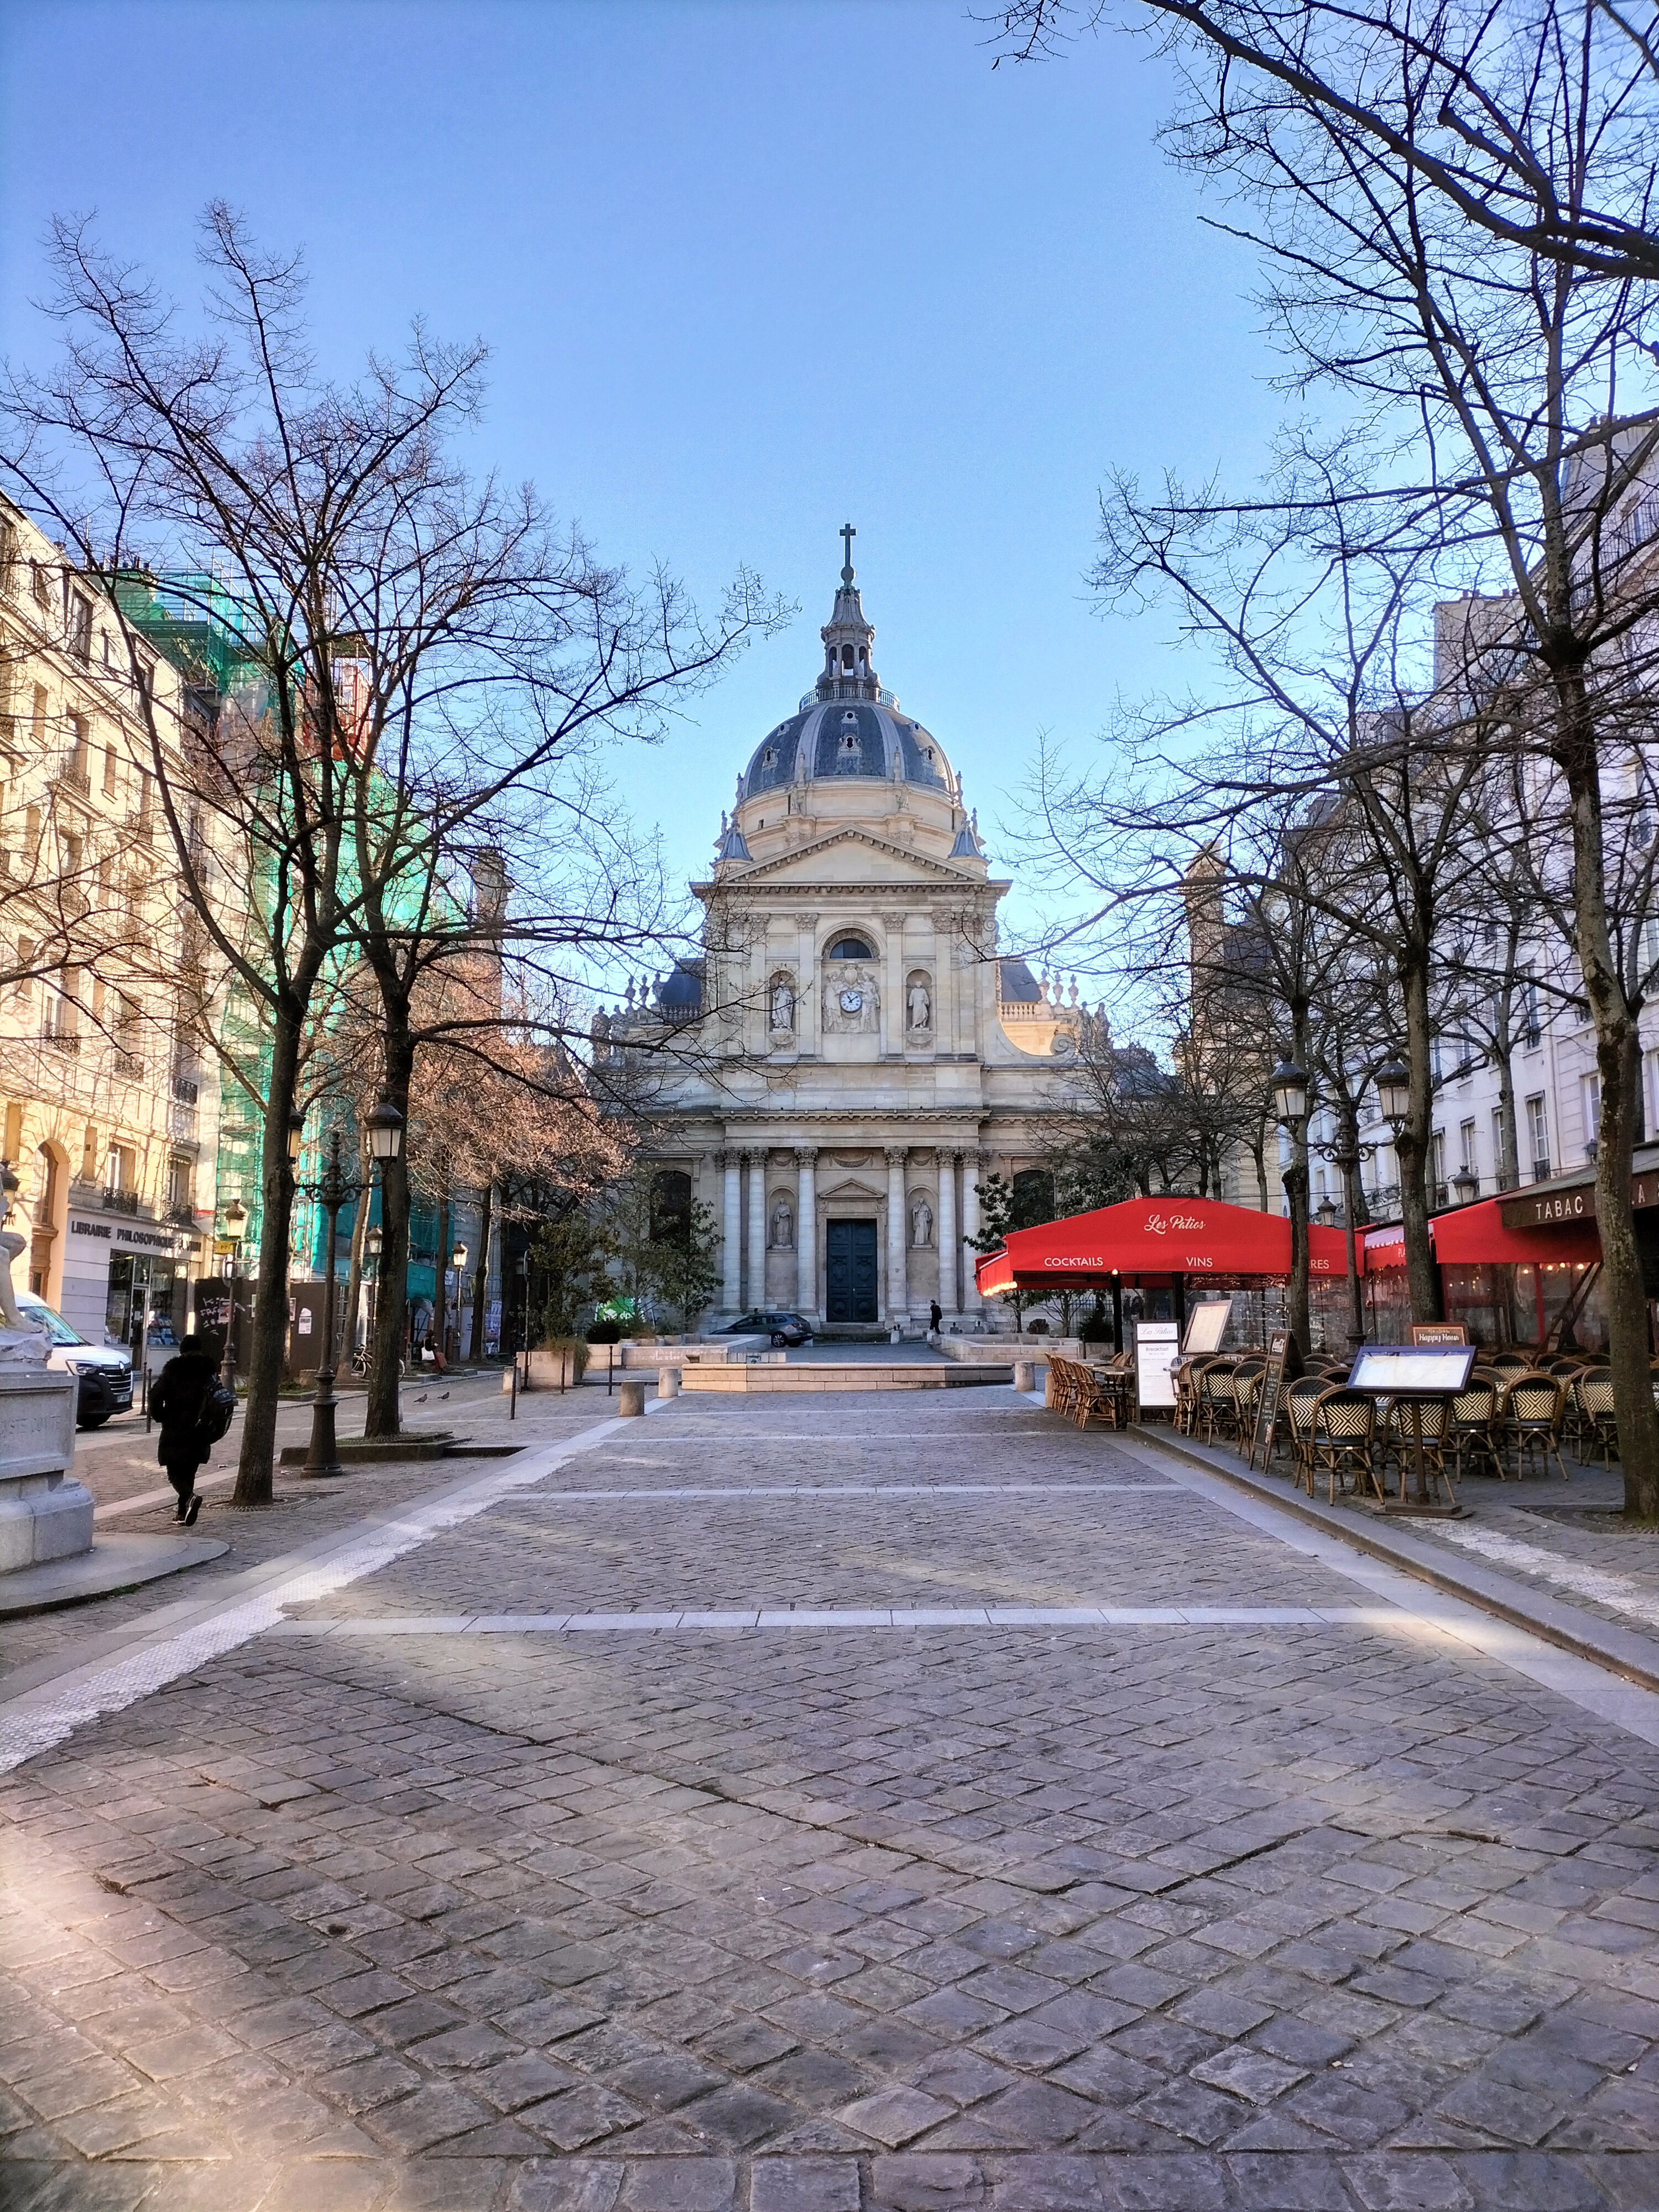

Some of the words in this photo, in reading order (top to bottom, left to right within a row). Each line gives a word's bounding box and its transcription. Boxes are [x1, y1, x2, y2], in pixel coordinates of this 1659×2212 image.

[1536, 1196, 1583, 1219] TABAC
[1144, 1214, 1168, 1235] Les
[1170, 1215, 1206, 1229] Patios
[71, 1220, 112, 1239] LIBRAIRIE
[117, 1228, 175, 1249] PHILOSOPHIQUE
[1044, 1256, 1104, 1267] COCKTAILS
[1186, 1256, 1213, 1267] VINS
[1308, 1259, 1329, 1269] RES
[1419, 1333, 1441, 1343] Happy
